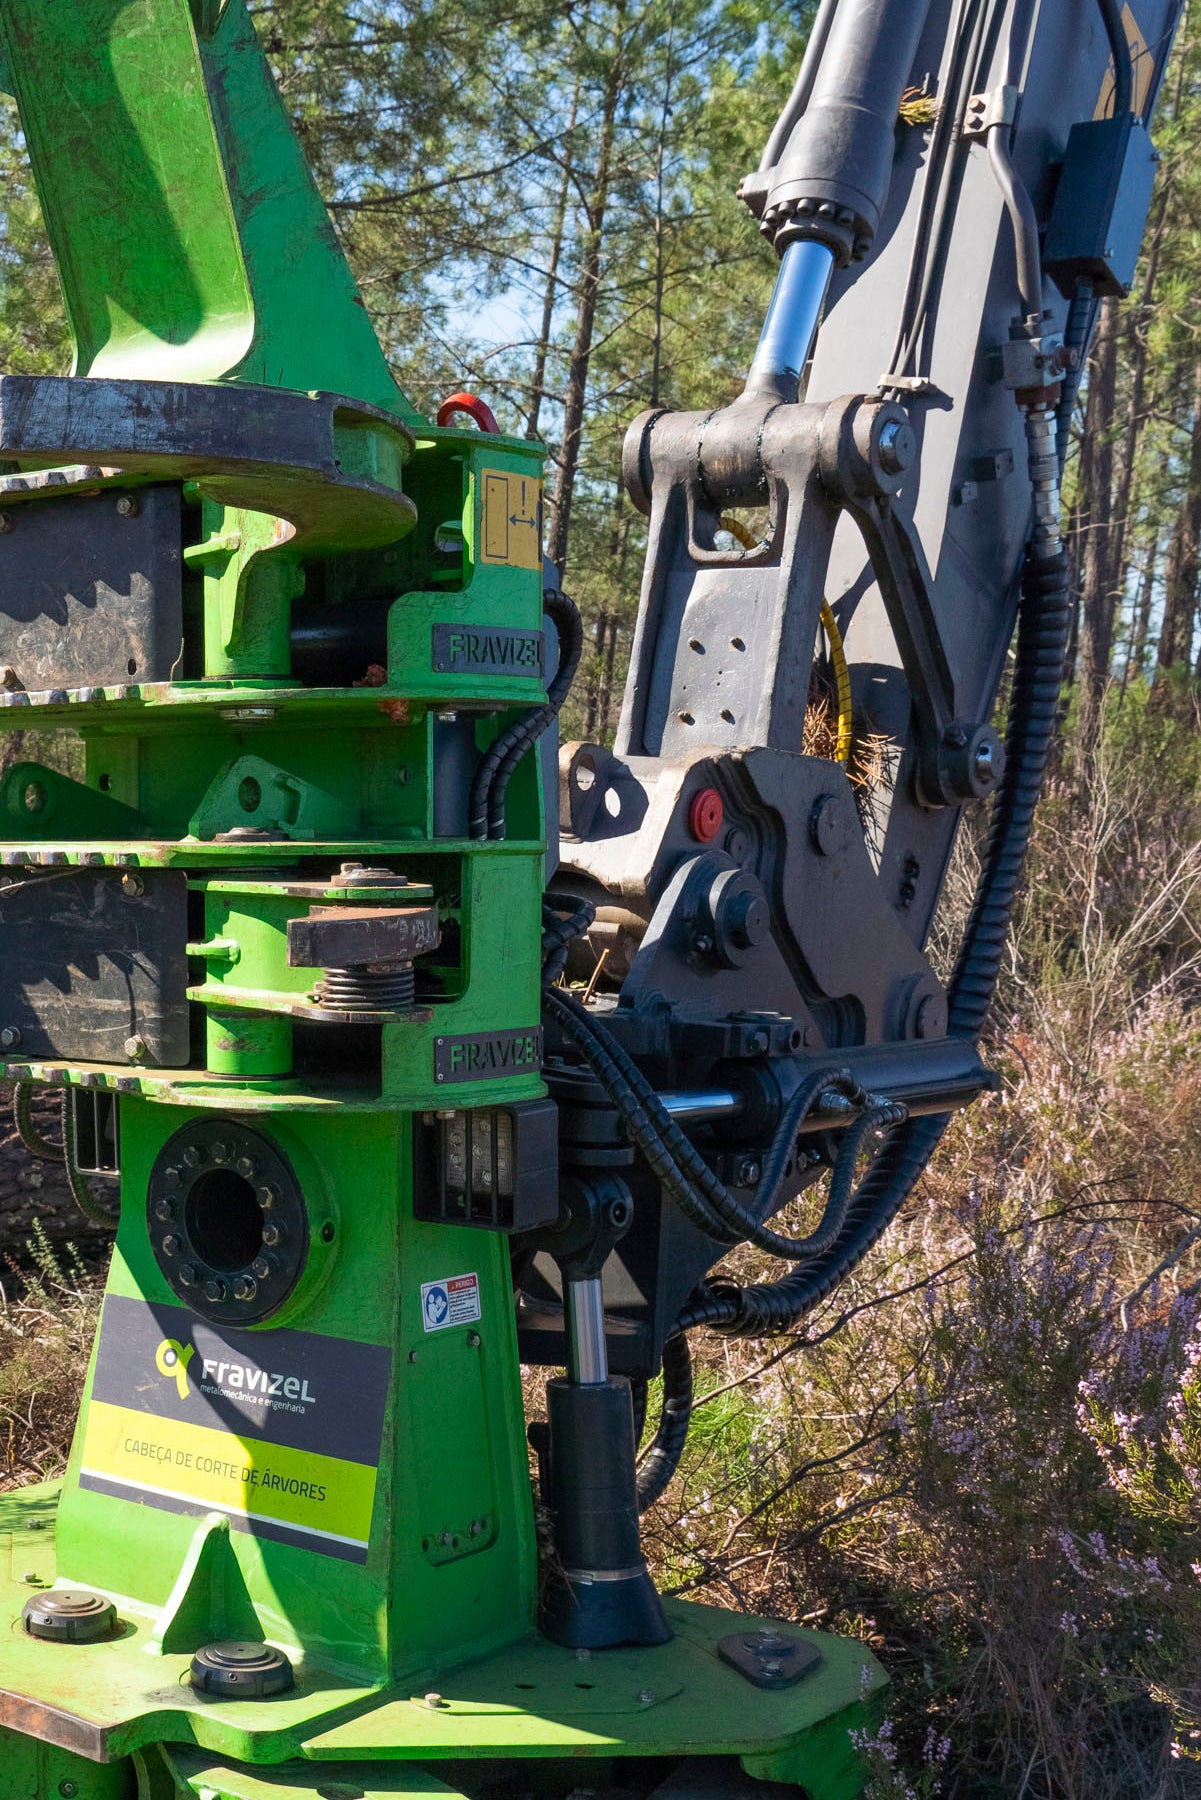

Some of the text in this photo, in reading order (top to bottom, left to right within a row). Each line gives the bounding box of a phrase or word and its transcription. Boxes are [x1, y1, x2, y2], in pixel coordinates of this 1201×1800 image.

[200, 1383, 306, 1414] metalomecânica e engenharia
[124, 1438, 327, 1502] CABEÇA DE CORTE DE ÁRVORES
